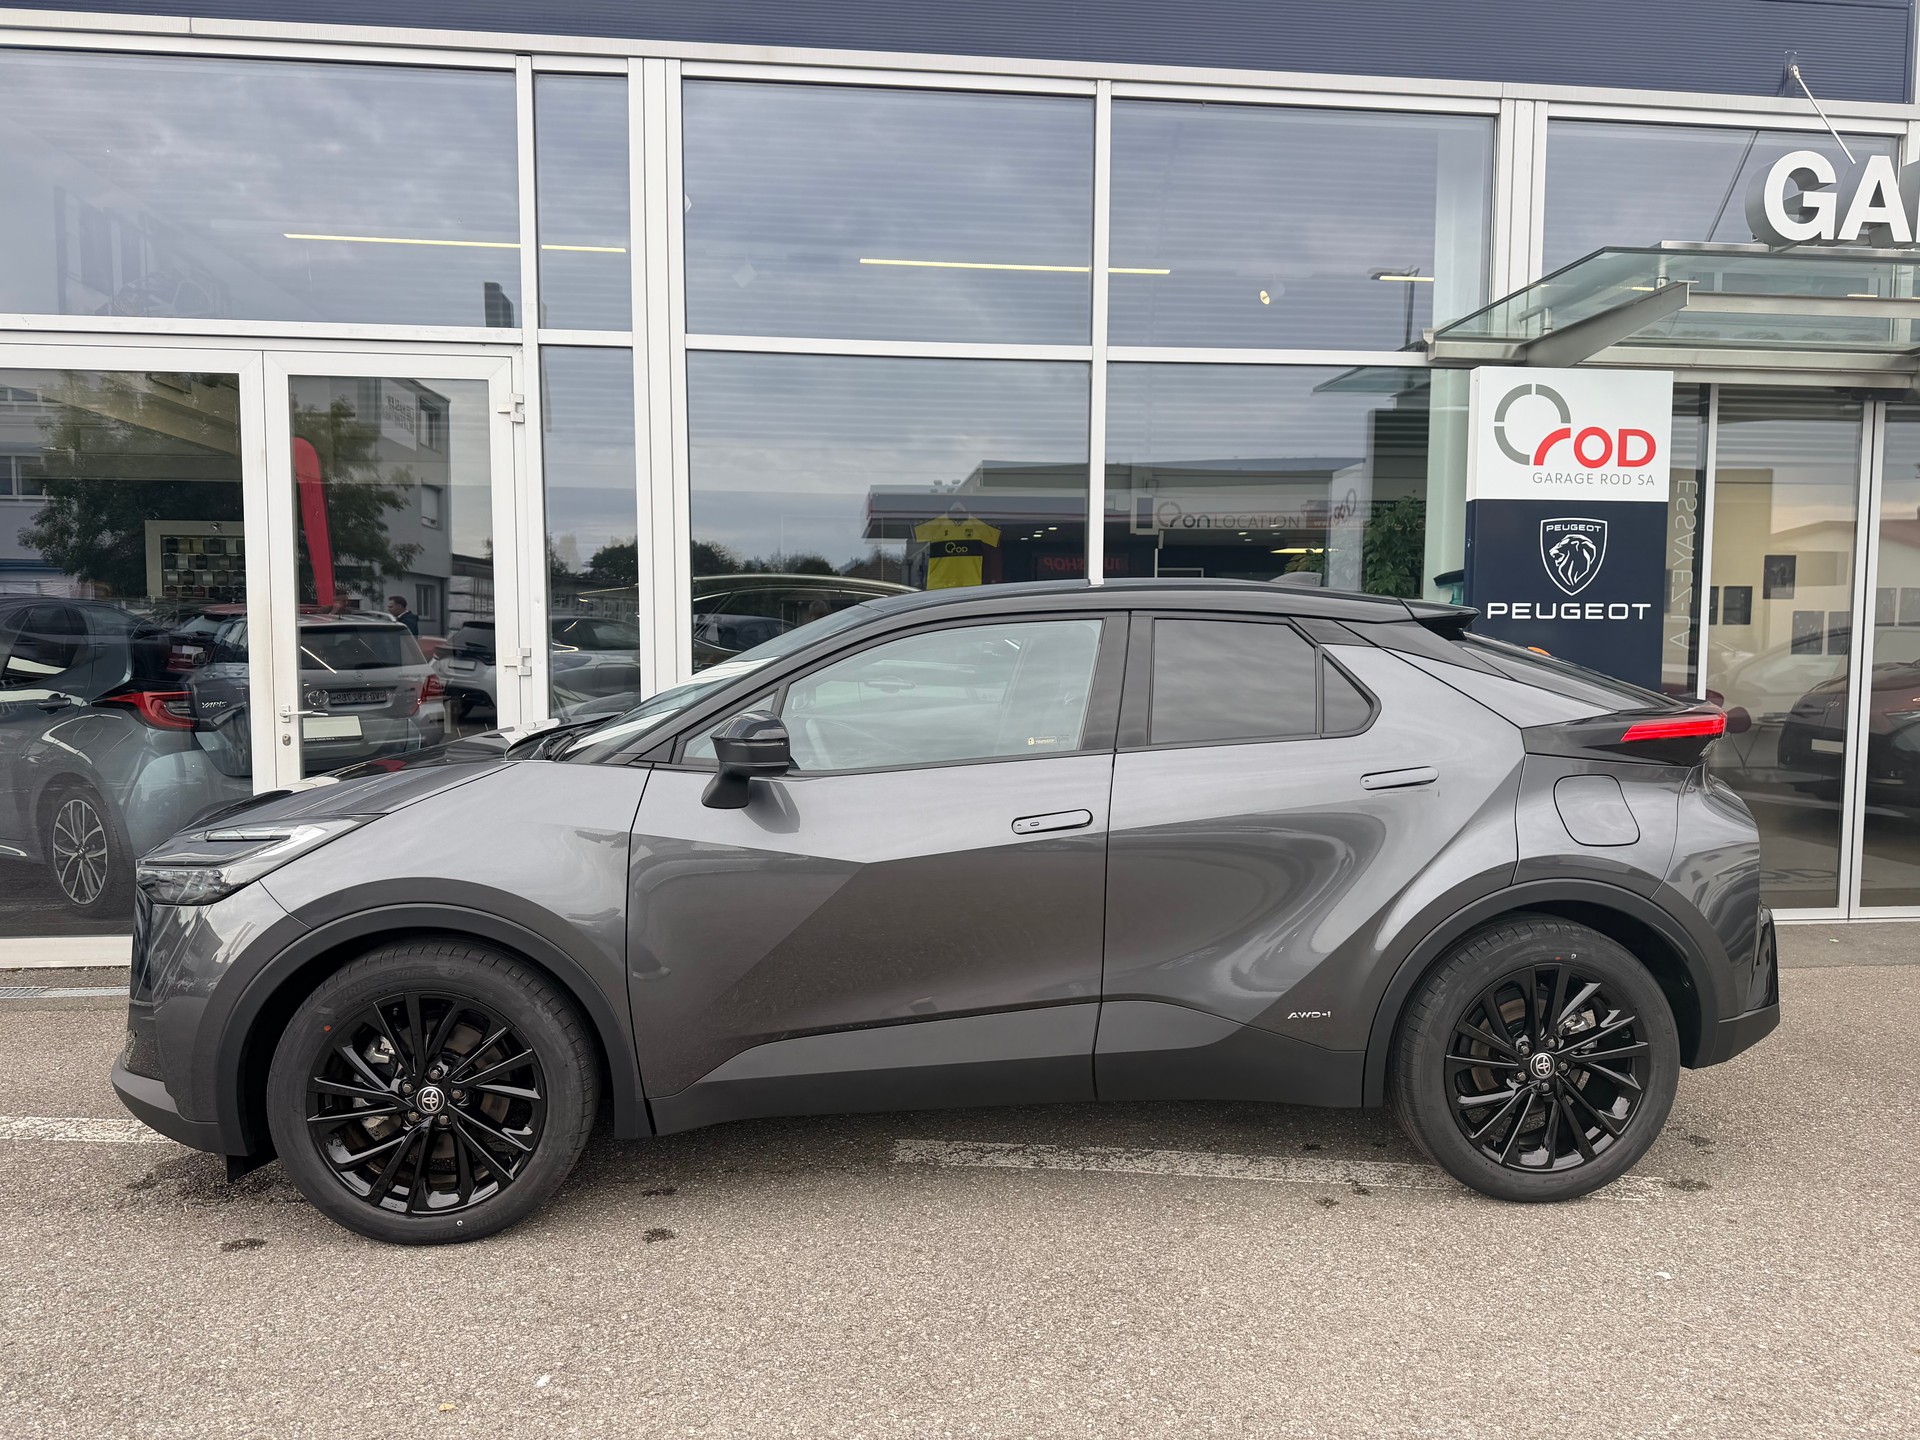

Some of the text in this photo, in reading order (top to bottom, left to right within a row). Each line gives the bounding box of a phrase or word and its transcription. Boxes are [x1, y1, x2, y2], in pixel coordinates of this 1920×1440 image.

[1764, 150, 1920, 243] GA
[1532, 472, 1655, 486] GARAGE ROD SA
[1546, 523, 1602, 532] PEUGEOT
[1487, 602, 1652, 620] PEUGEOT
